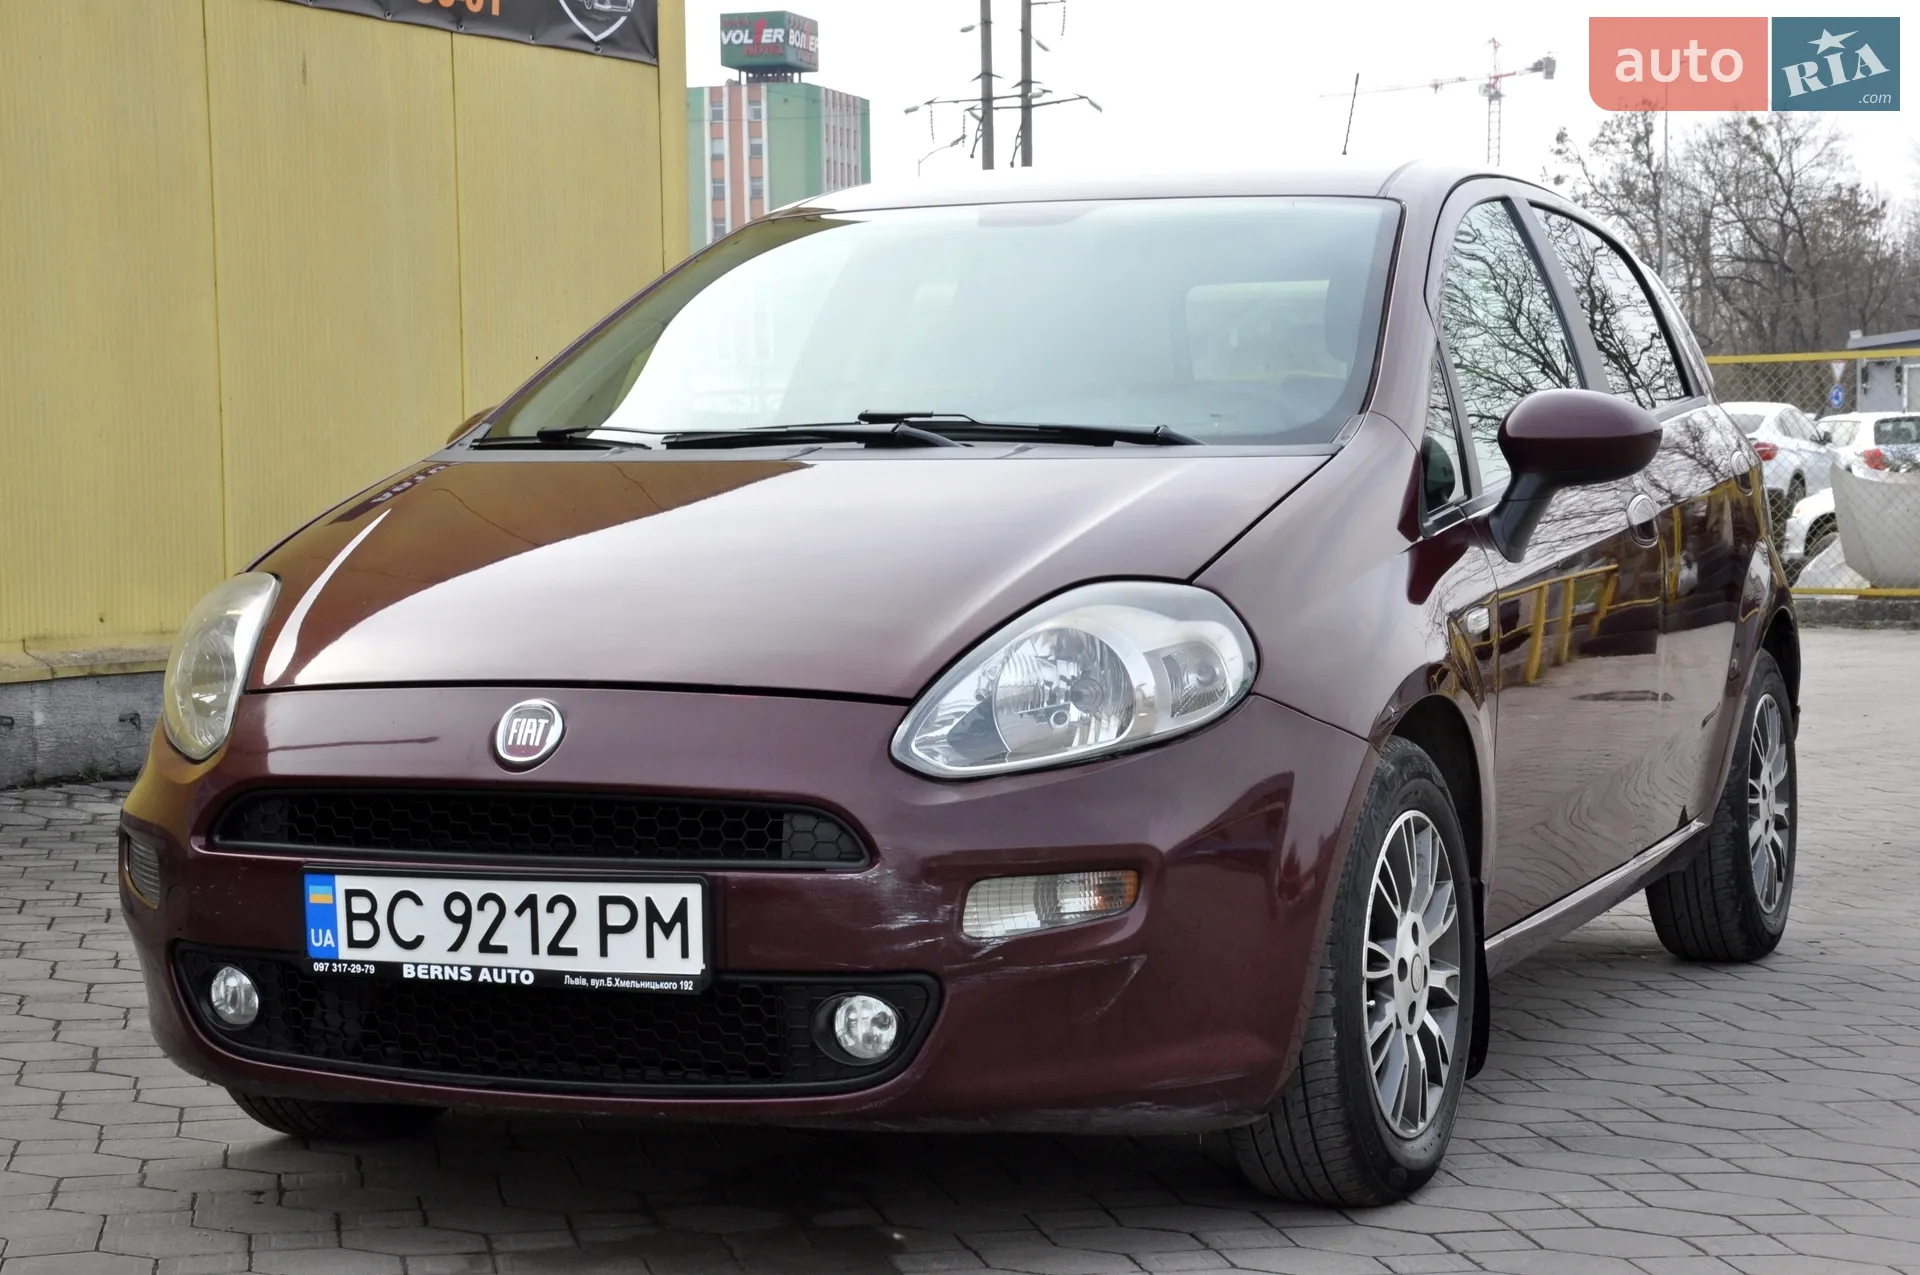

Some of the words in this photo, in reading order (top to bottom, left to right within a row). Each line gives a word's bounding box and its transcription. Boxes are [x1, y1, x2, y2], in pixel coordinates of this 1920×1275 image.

[507, 717, 550, 747] FIAT
[344, 887, 426, 951] BC
[443, 890, 579, 957] 9212
[598, 894, 691, 960] PM
[310, 929, 336, 949] UA
[313, 962, 330, 972] 097
[331, 962, 376, 975] 317-29-79
[402, 964, 473, 982] BERNS
[478, 967, 535, 986] AUTO
[564, 974, 589, 988] Львів,
[679, 980, 694, 991] 192
